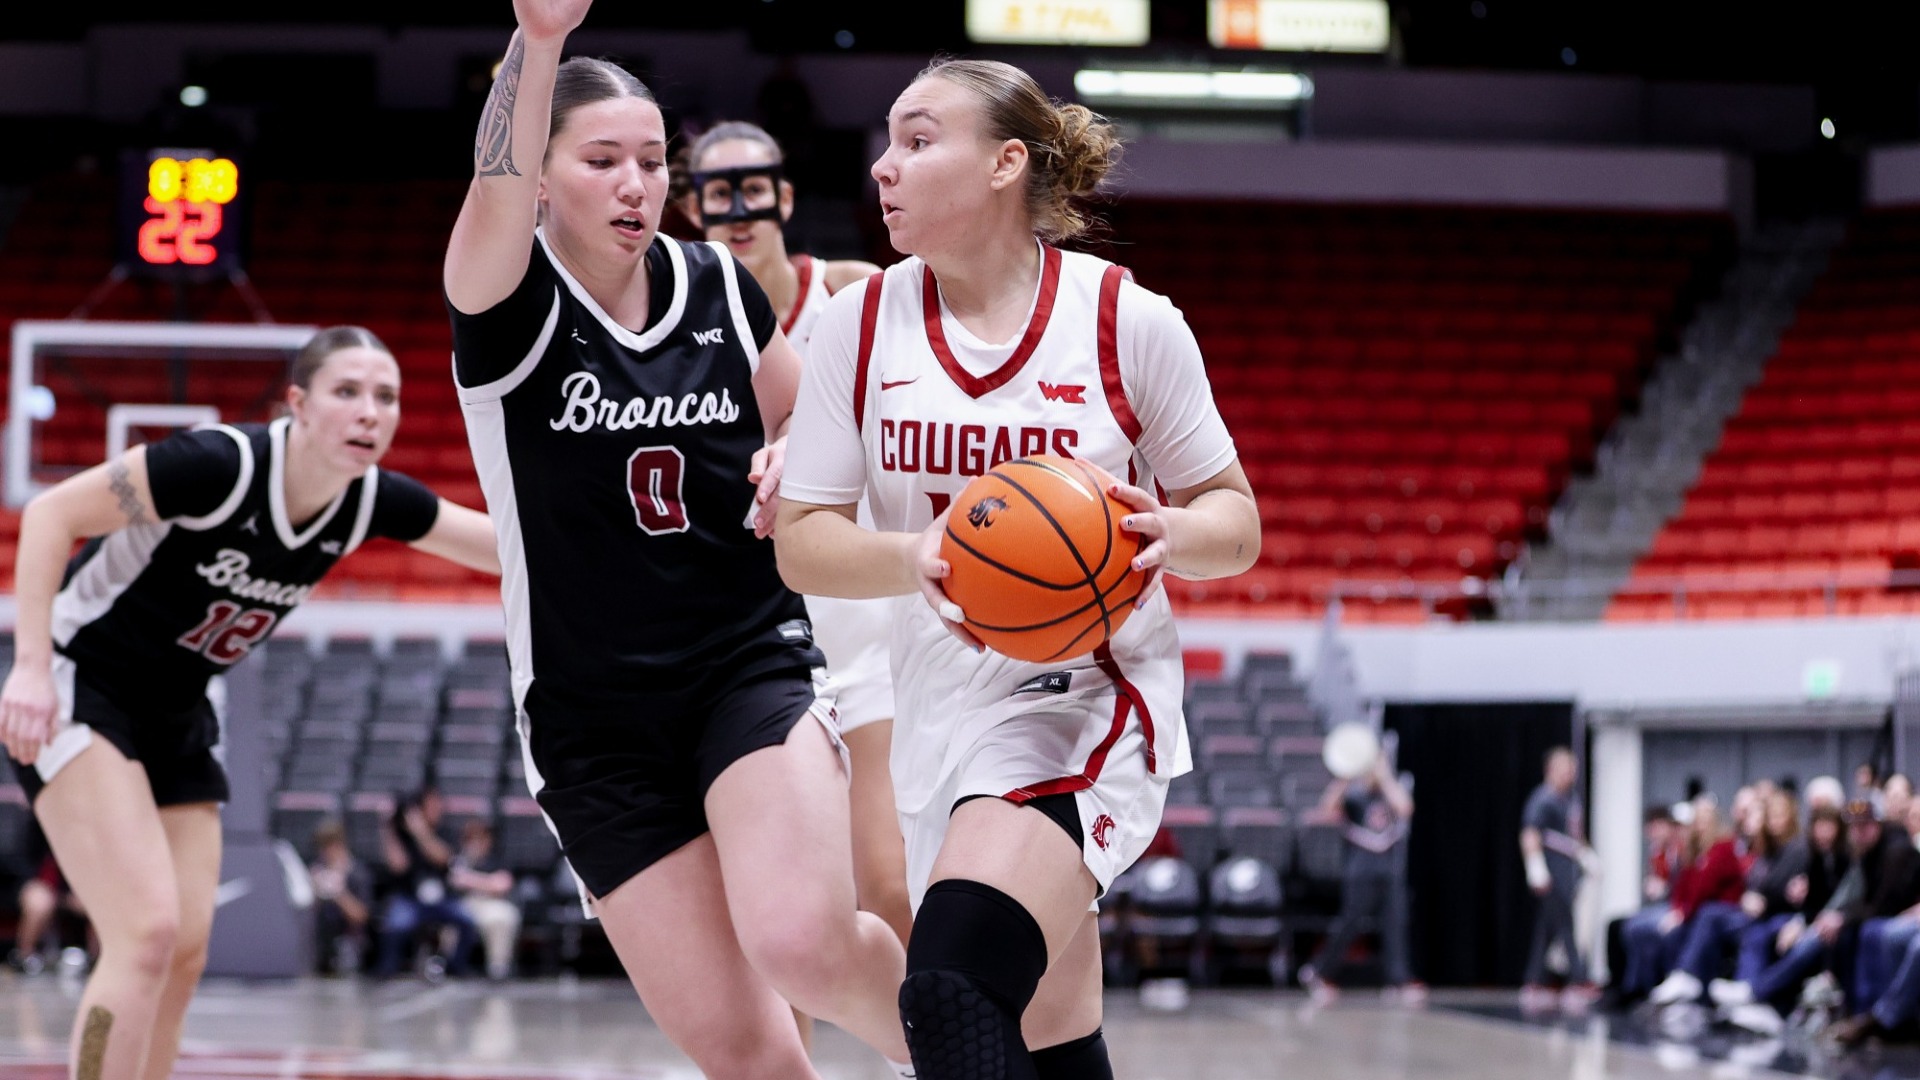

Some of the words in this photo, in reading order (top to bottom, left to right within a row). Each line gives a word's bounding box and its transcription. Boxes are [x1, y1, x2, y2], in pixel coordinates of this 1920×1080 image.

[138, 197, 222, 264] 22
[550, 371, 740, 433] Broncos
[881, 418, 1078, 477] COUGARS
[626, 445, 691, 536] 0
[176, 599, 276, 664] 12
[1049, 677, 1062, 686] XL
